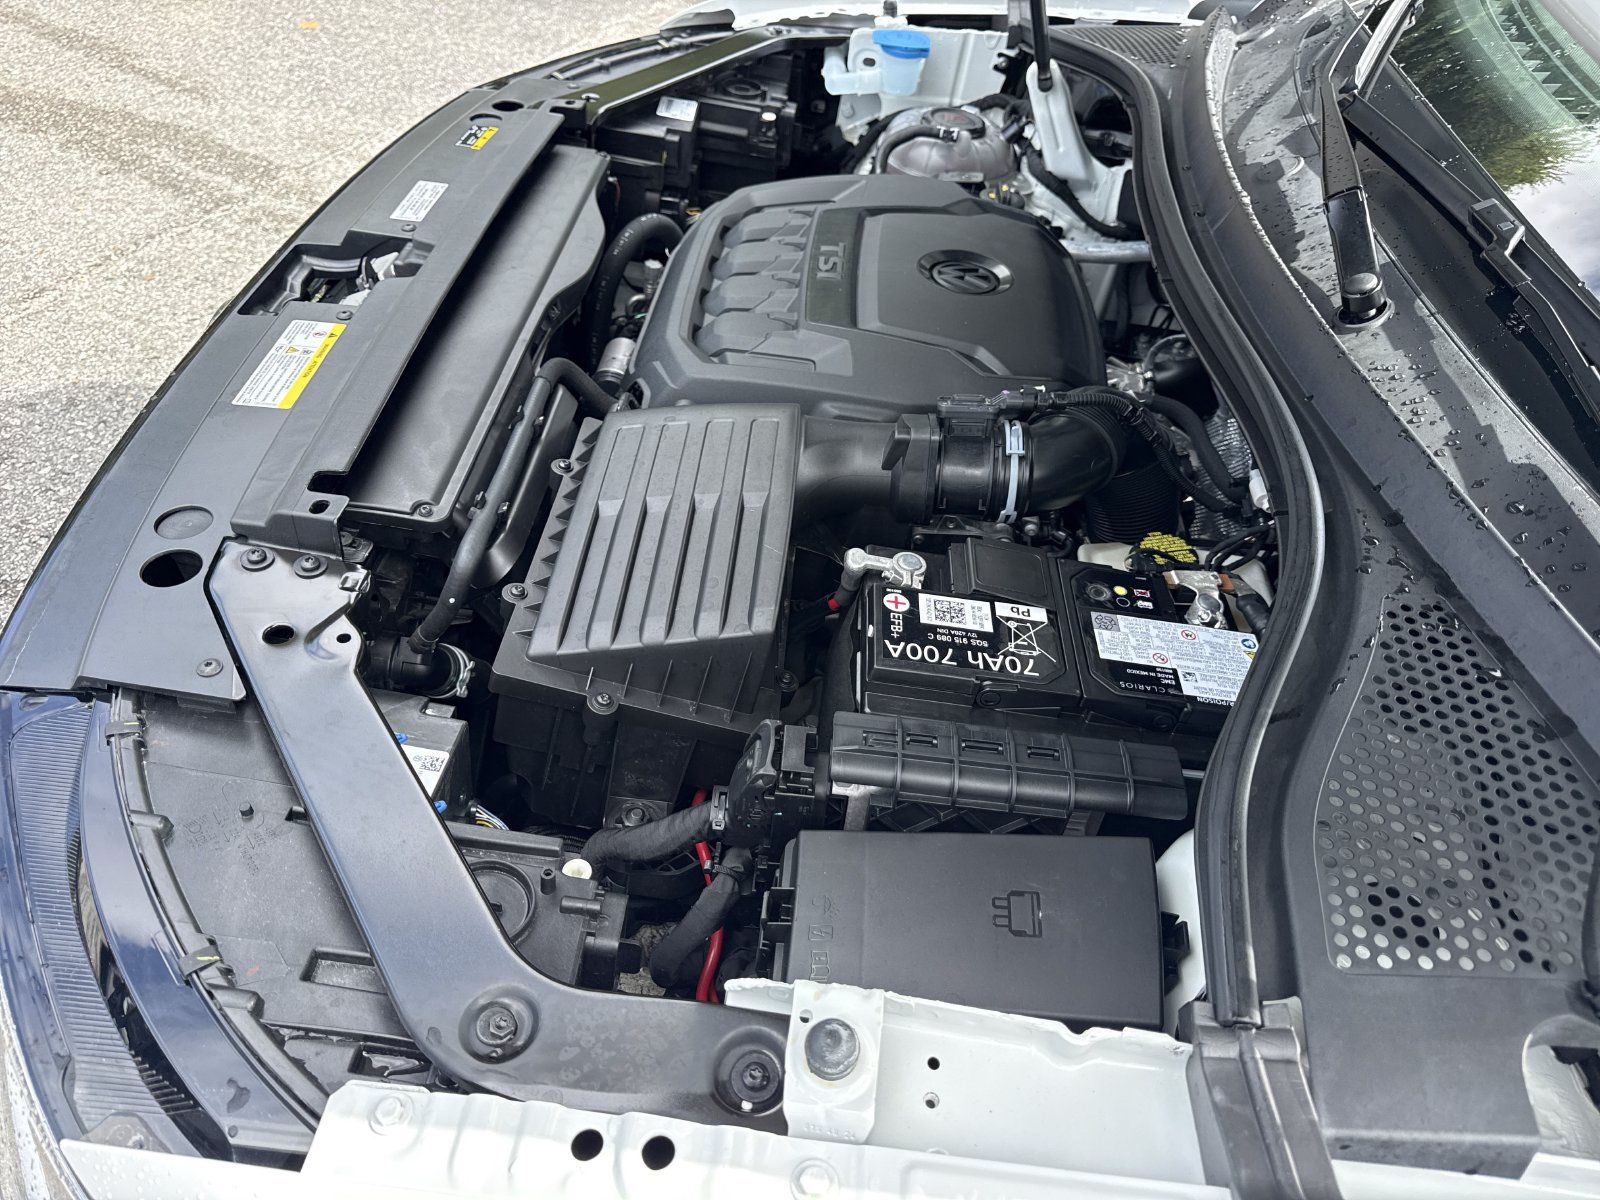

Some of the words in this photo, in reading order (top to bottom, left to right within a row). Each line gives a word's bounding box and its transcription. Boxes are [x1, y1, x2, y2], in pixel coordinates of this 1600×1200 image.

[816, 242, 846, 280] TSI
[1010, 605, 1031, 618] Pb
[890, 613, 903, 639] EFB+
[927, 632, 934, 640] C
[953, 637, 968, 645] 915
[884, 639, 958, 666] 700A
[967, 650, 1040, 677] 70Ah
[1126, 668, 1149, 676] MEXICO
[1157, 671, 1174, 679] MADE
[1119, 681, 1166, 693] CLARIOS
